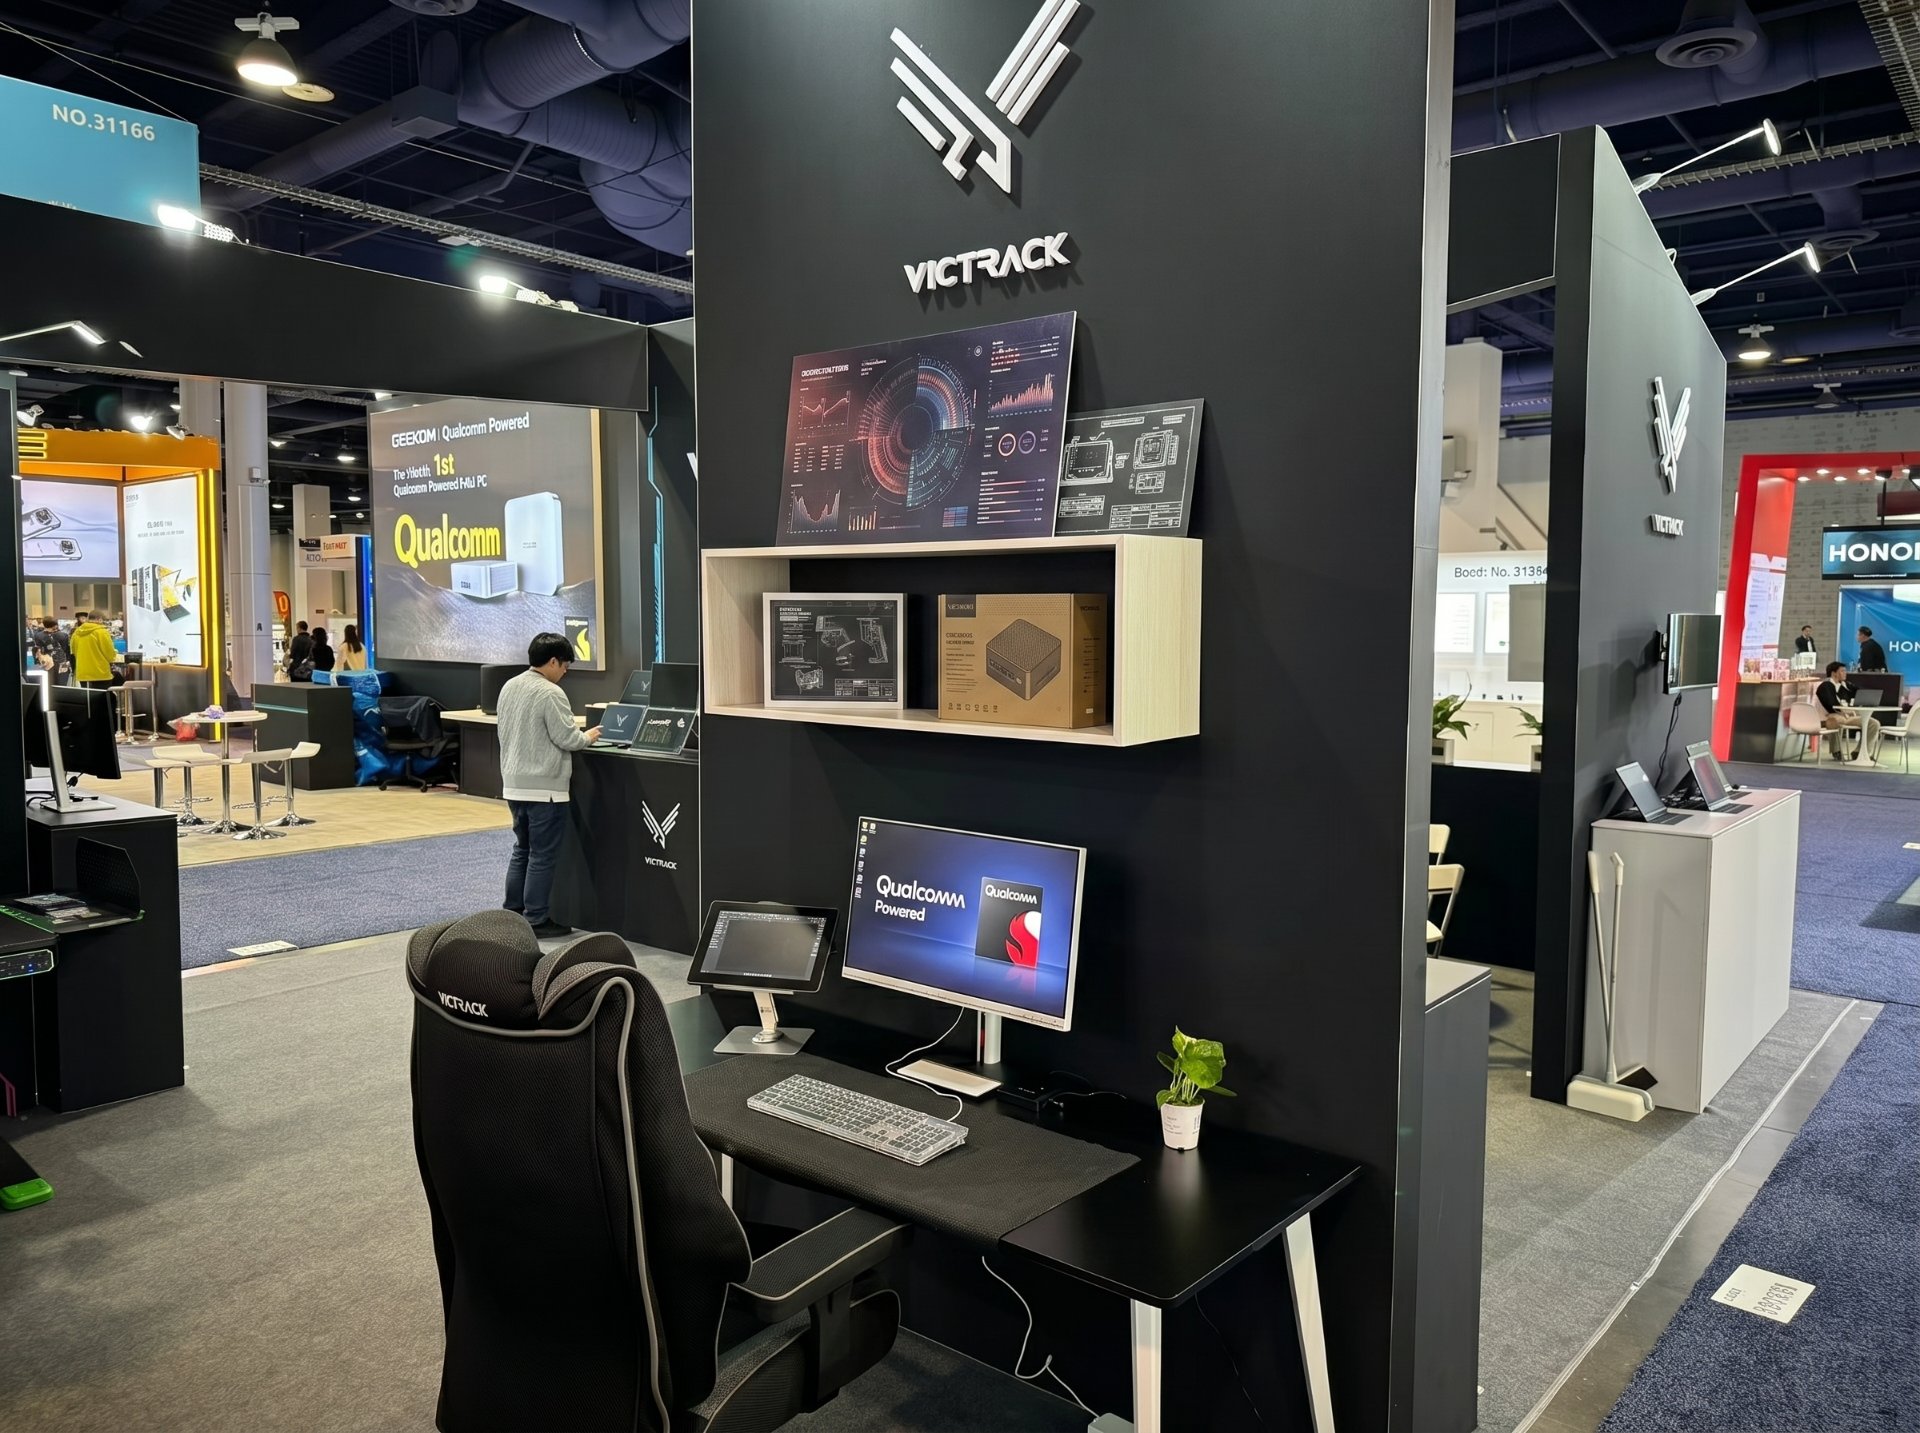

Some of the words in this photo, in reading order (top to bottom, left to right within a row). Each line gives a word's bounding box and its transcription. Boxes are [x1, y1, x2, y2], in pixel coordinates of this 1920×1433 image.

[53, 104, 155, 141] NO.31166
[904, 232, 1071, 293] VICTRACK
[391, 428, 436, 448] GEEKOM
[442, 422, 487, 442] Qualcomm
[488, 411, 530, 433] Powered
[433, 453, 455, 476] 1st
[428, 477, 458, 493] Powered
[476, 475, 488, 488] PC
[394, 513, 500, 569] Qualcomm
[1491, 566, 1510, 577] No.
[876, 874, 966, 909] Qualcomm
[984, 883, 1038, 904] Qualcomm
[874, 899, 926, 922] Powered
[437, 990, 489, 1018] VICTRACK
